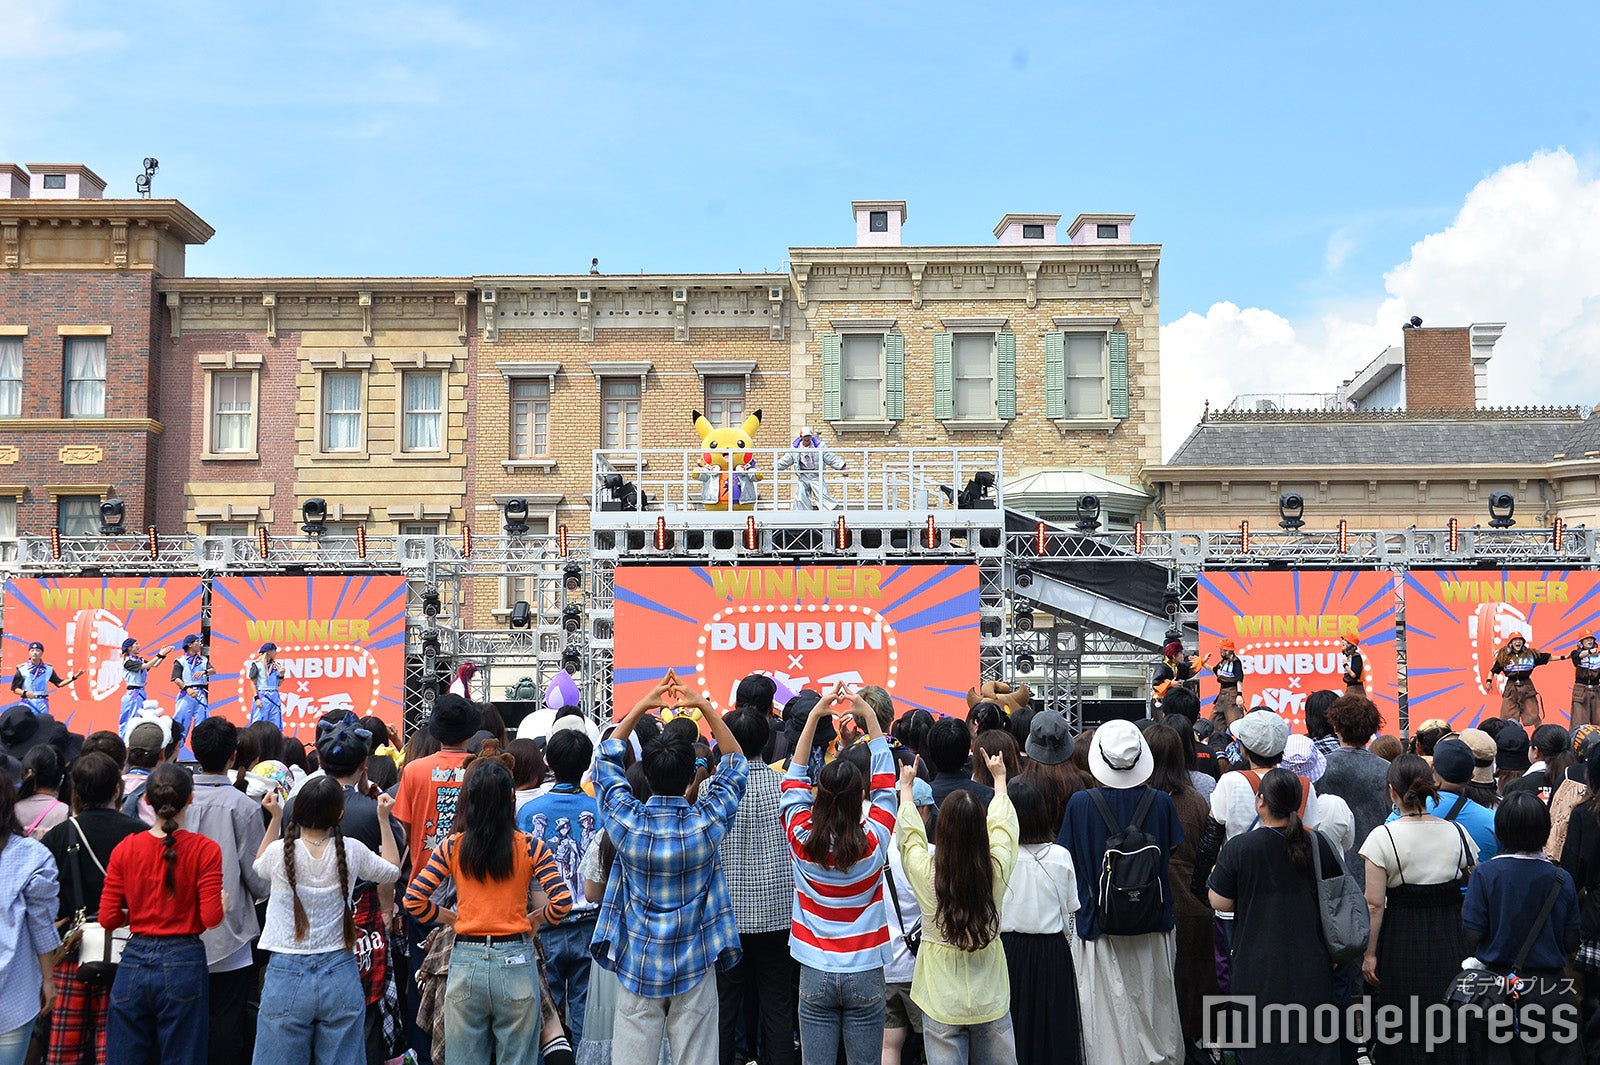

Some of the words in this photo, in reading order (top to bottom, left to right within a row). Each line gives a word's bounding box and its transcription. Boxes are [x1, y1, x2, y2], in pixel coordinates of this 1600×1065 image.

[711, 569, 882, 599] WINNER
[1440, 581, 1569, 604] WINNER
[40, 588, 167, 610] WINNER
[246, 619, 370, 641] WINNER
[711, 622, 882, 650] BUNBUN
[1233, 615, 1360, 637] WINNER
